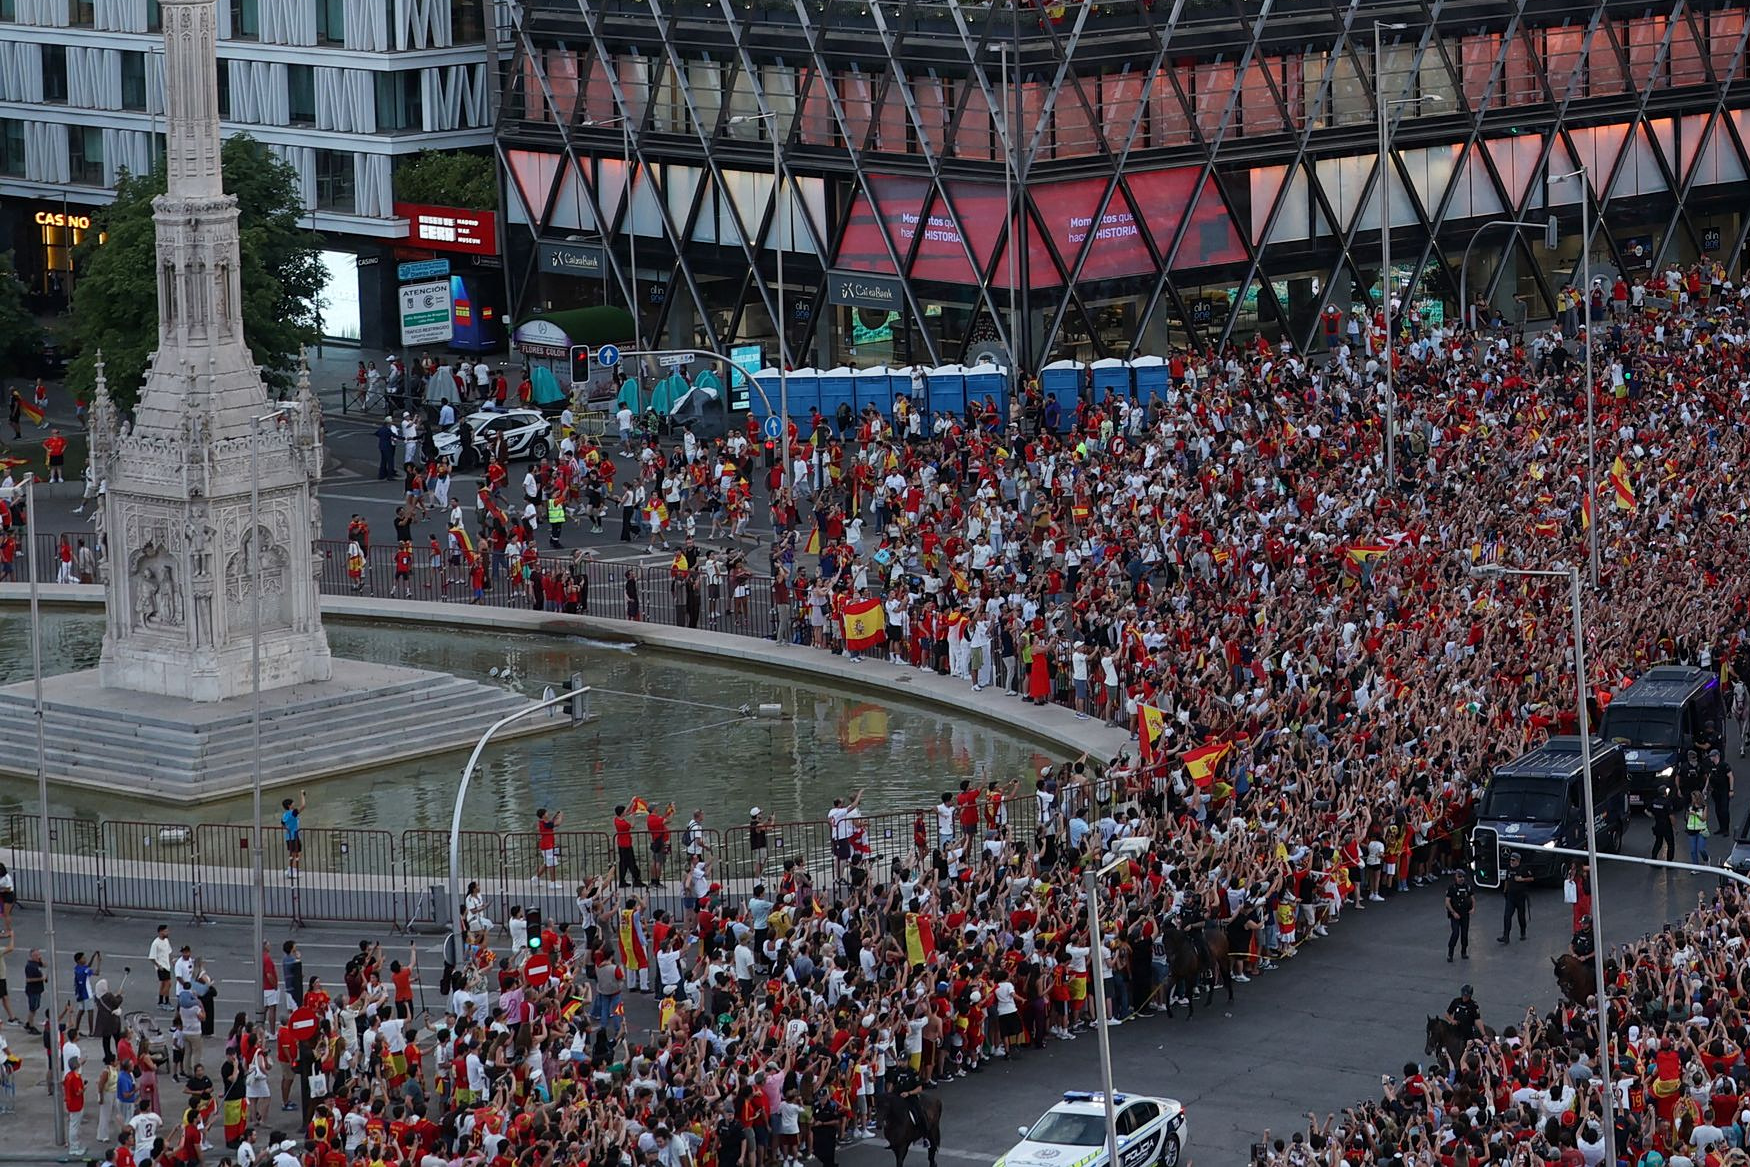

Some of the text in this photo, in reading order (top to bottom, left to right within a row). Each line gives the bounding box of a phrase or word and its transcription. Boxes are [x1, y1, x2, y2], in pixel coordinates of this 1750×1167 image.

[35, 211, 90, 229] CASNO
[902, 213, 944, 227] Momtos
[1070, 214, 1117, 228] Momtos
[925, 230, 962, 242] HISTORIA
[1096, 225, 1138, 240] HISTORIA
[358, 257, 379, 266] CASINO
[403, 285, 447, 297] ATENCIÓN
[522, 346, 544, 355] FLORES
[1631, 1095, 1643, 1108] 19
[144, 1123, 153, 1138] 2
